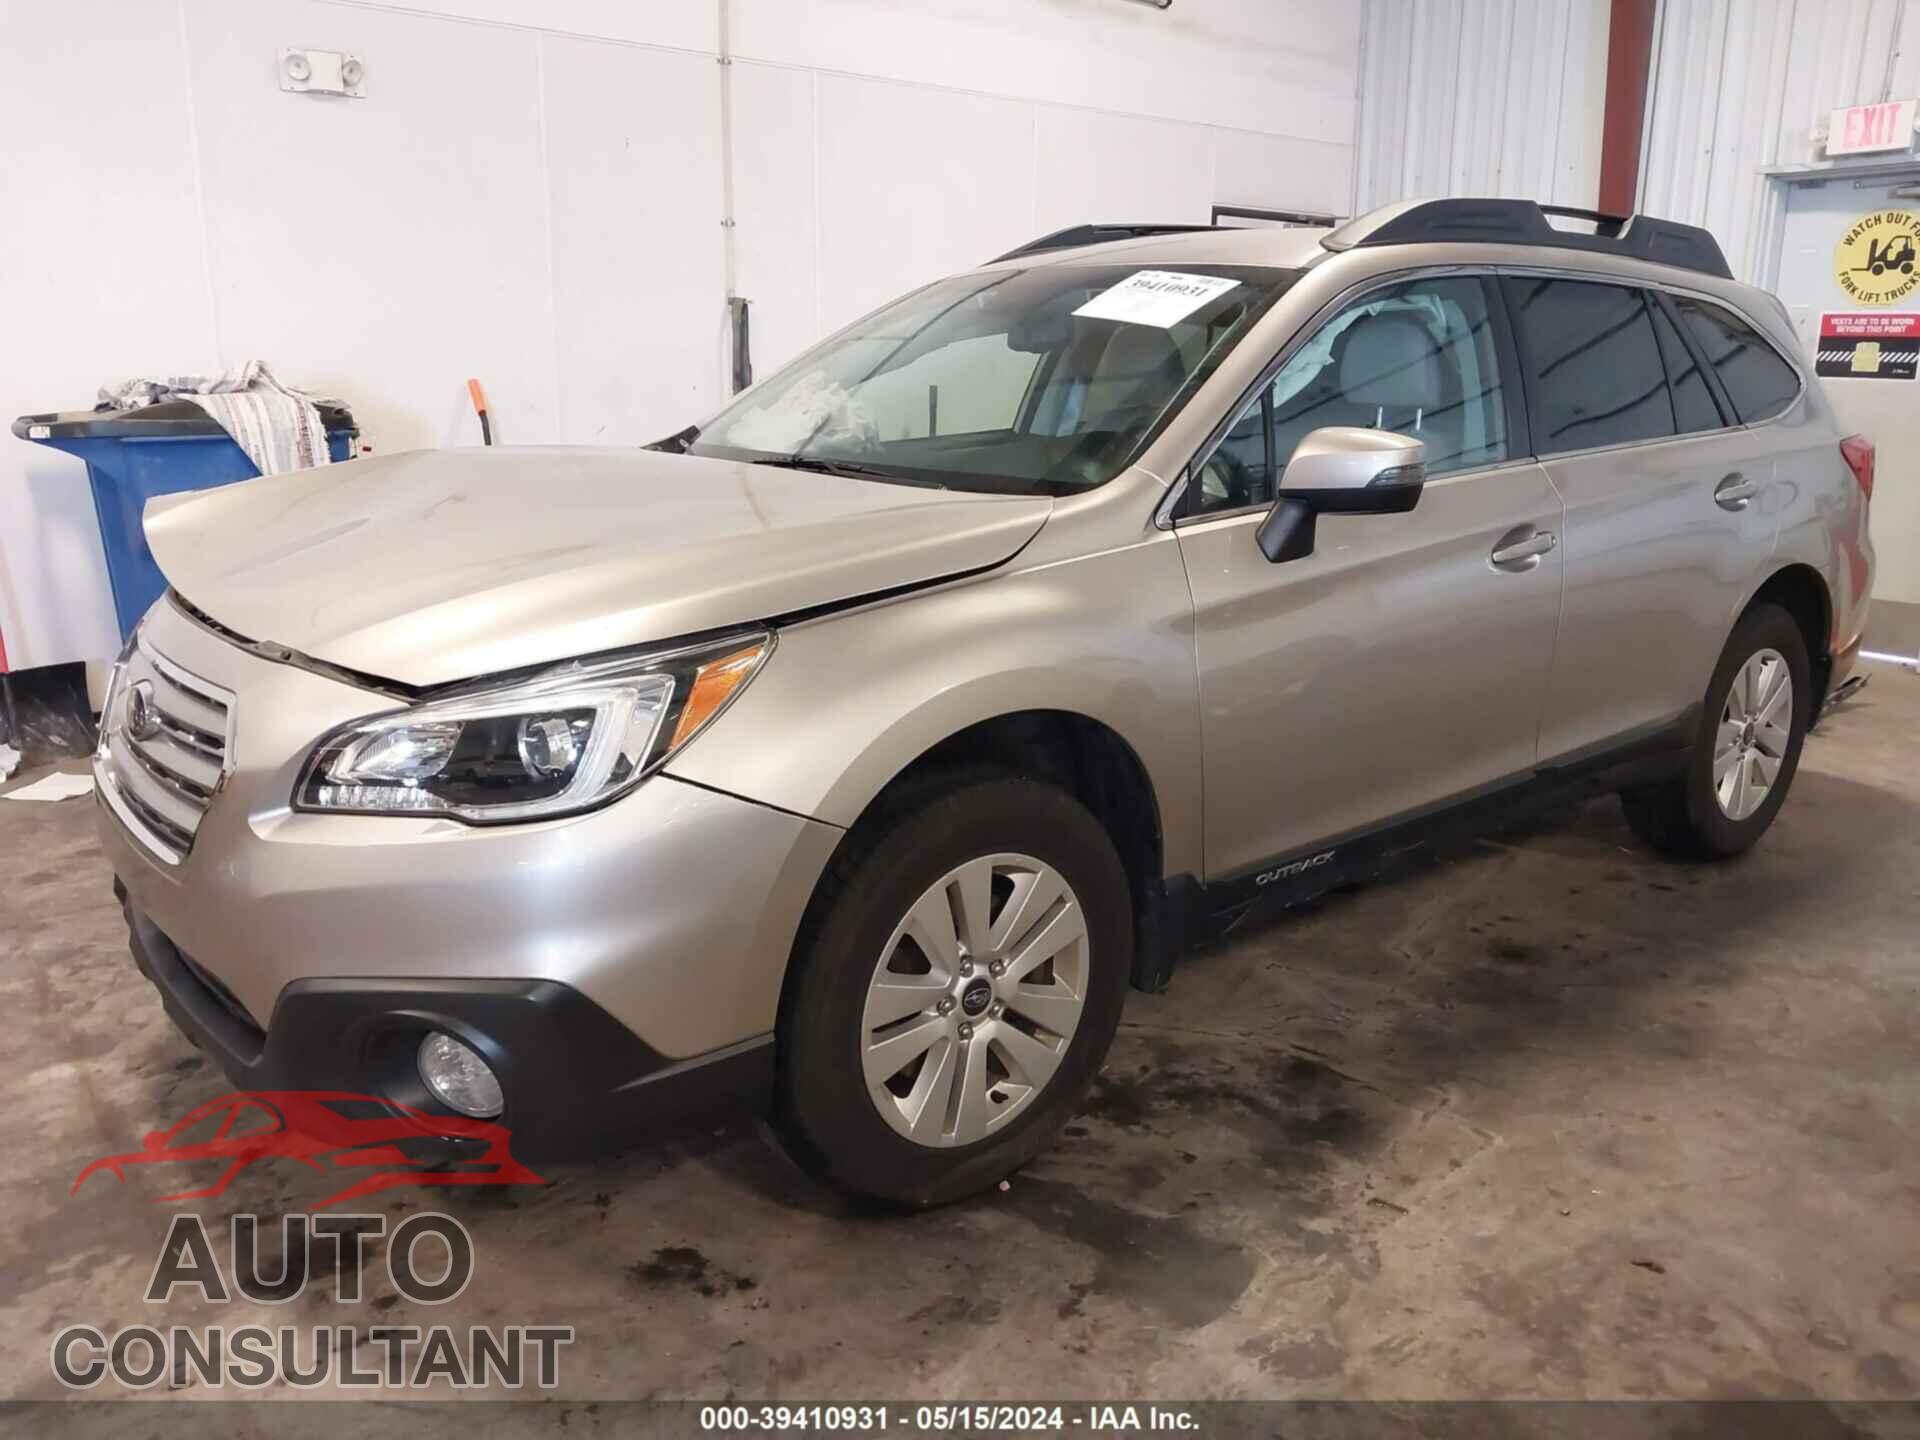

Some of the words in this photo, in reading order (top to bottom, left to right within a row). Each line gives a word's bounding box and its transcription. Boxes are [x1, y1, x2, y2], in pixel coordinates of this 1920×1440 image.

[1842, 104, 1902, 148] EXIT
[1843, 214, 1882, 247] WATCH
[1886, 212, 1912, 226] OUT
[1839, 271, 1858, 295] FORK
[1857, 290, 1881, 303] LIFT
[1884, 270, 1920, 300] TRUCKS
